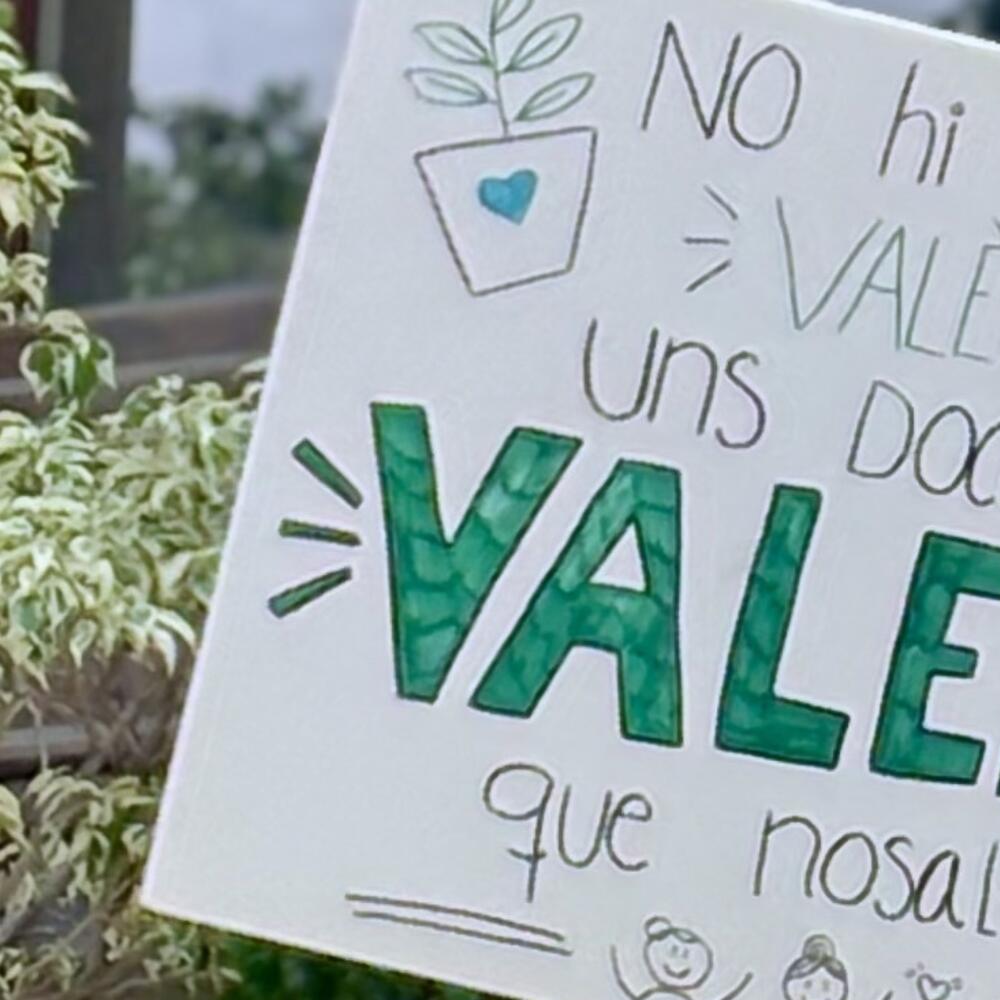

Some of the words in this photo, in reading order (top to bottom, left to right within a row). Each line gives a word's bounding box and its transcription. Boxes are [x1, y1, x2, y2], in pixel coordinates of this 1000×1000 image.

[641, 20, 802, 151] NO
[878, 61, 965, 187] hi
[582, 318, 766, 449] uns
[482, 762, 653, 904] que
